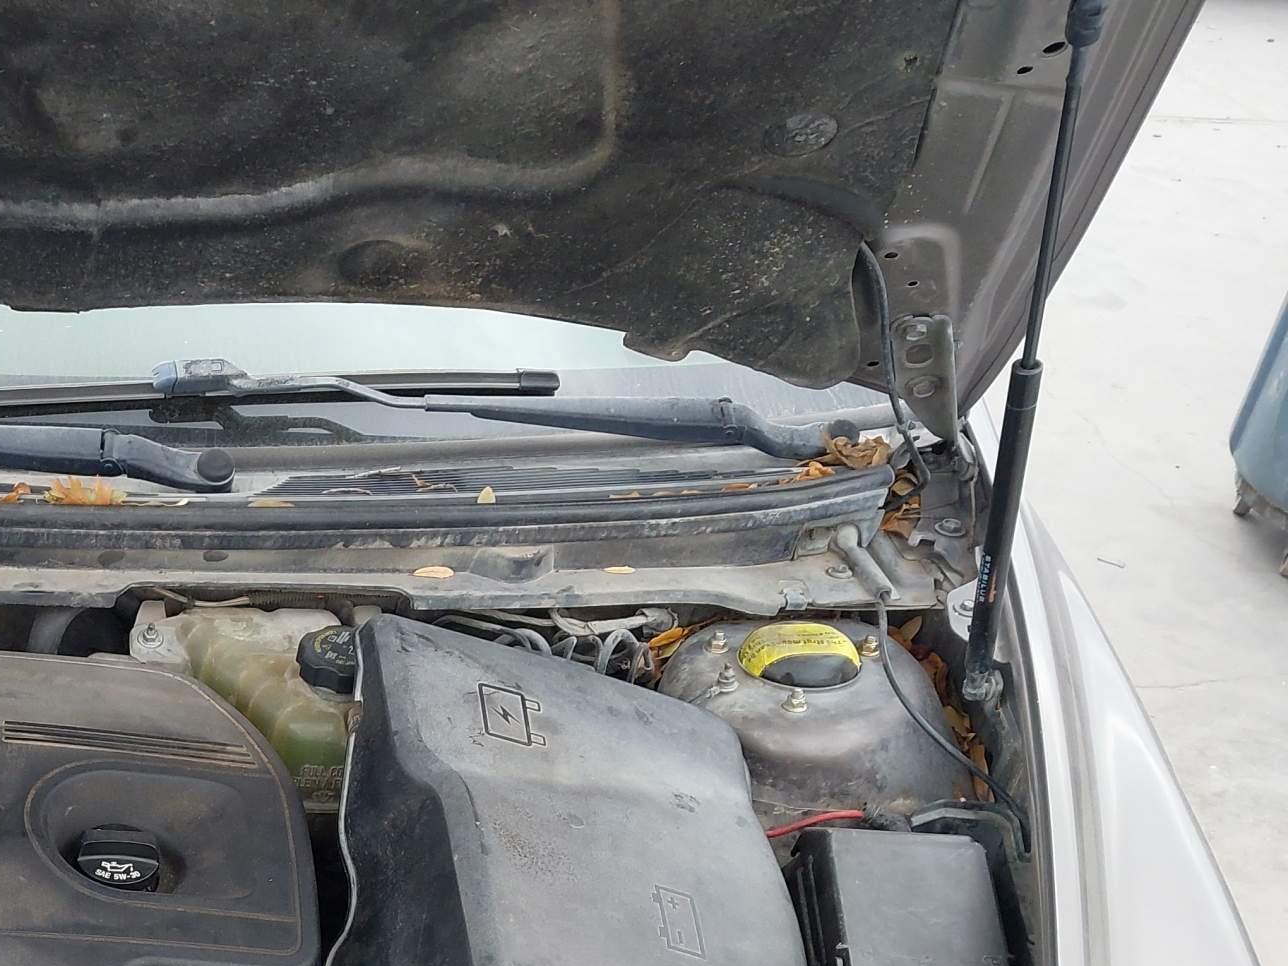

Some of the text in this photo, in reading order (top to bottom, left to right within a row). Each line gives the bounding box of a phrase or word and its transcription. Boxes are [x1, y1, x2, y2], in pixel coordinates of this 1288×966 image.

[329, 765, 344, 777] CO
[95, 869, 140, 880] SAE 5W-30
